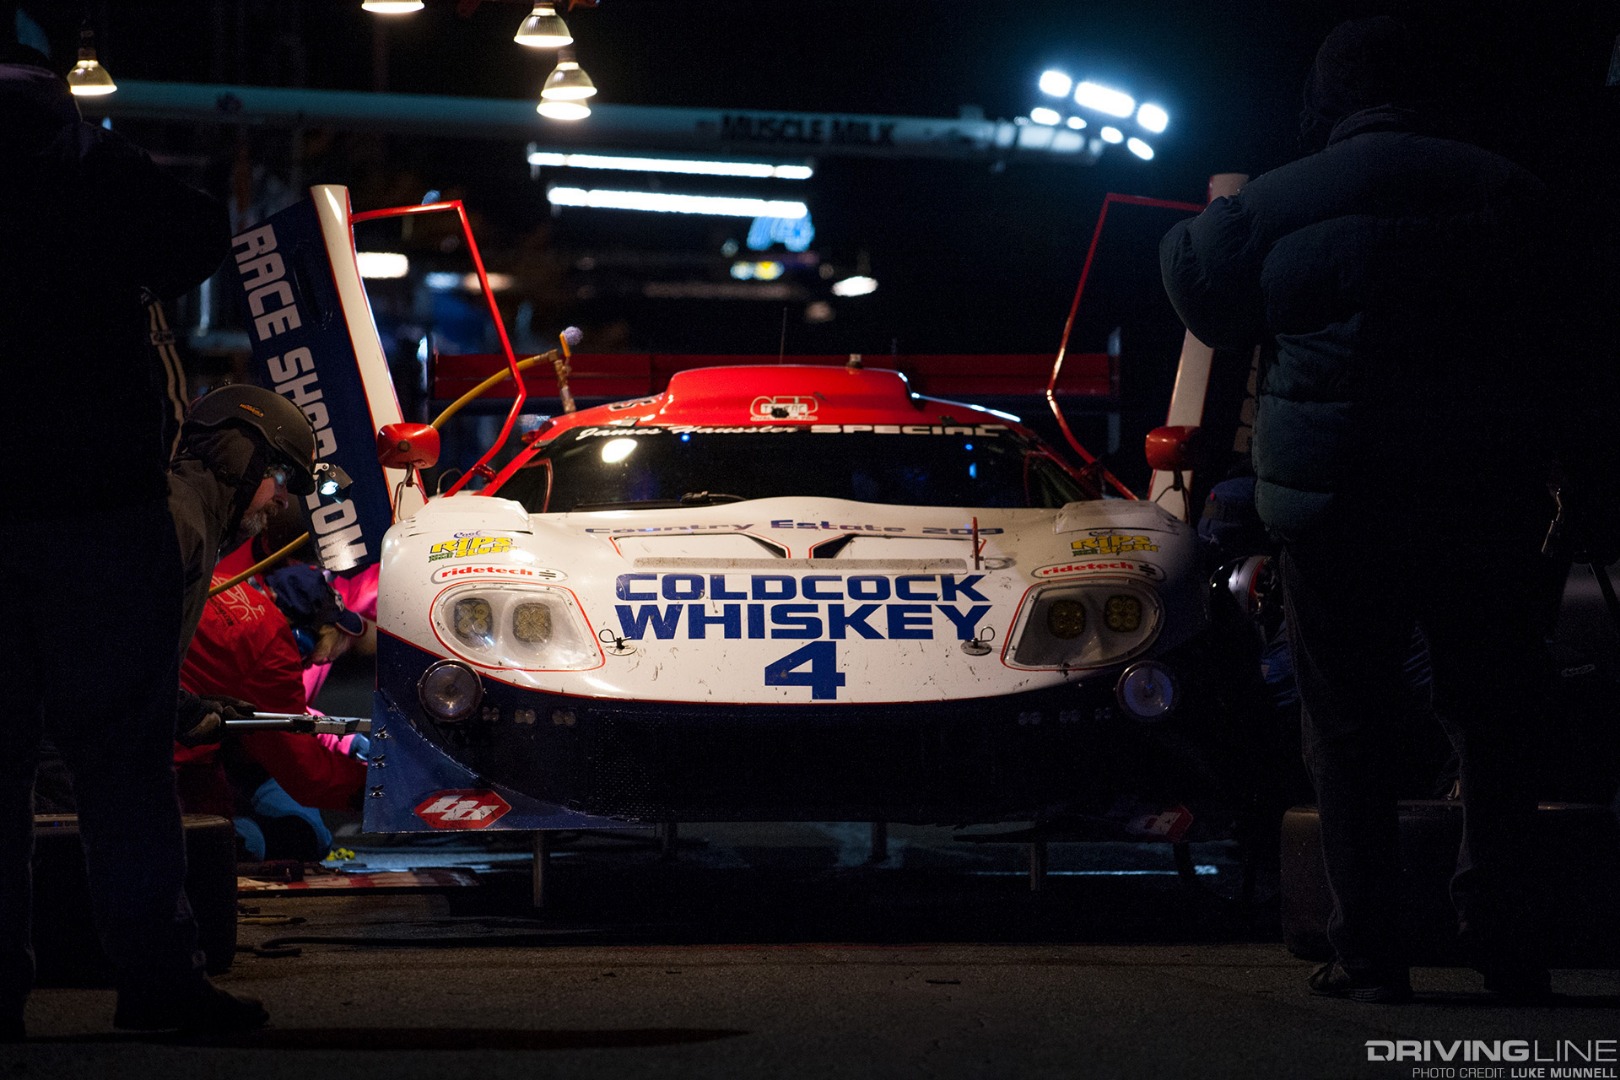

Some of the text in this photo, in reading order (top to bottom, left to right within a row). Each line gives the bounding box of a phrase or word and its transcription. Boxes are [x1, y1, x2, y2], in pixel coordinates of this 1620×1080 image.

[722, 113, 822, 143] MUSCLE
[831, 117, 895, 145] MILK
[231, 224, 367, 571] RACE SHPOM
[575, 426, 662, 441] James
[585, 523, 754, 534] Country
[771, 519, 906, 533] Estate
[430, 537, 514, 554] RIPS
[1071, 535, 1152, 549] RIPS
[442, 566, 533, 578] ridetech
[1043, 562, 1134, 575] ridetech
[615, 574, 992, 601] COLDCOCK
[614, 603, 993, 640] WHISKEY
[764, 641, 846, 699] 4
